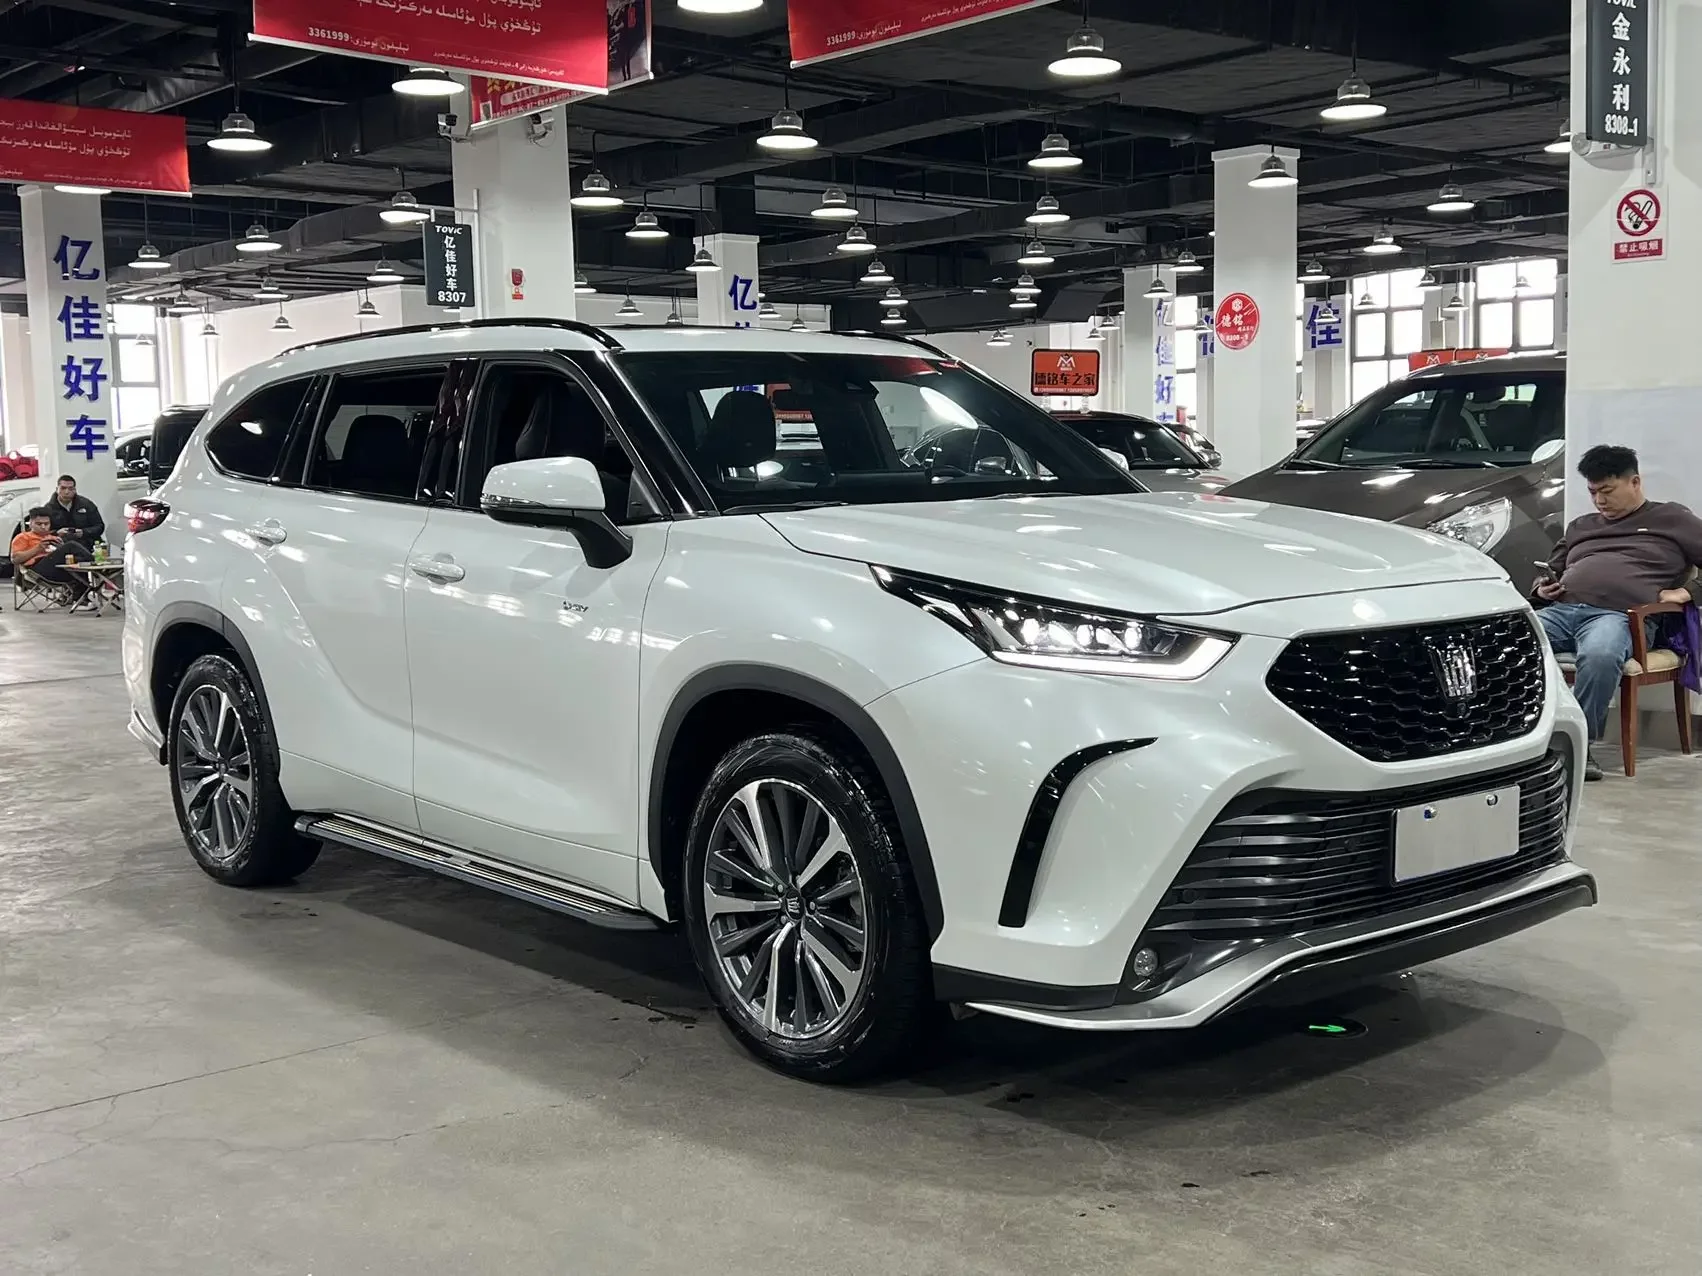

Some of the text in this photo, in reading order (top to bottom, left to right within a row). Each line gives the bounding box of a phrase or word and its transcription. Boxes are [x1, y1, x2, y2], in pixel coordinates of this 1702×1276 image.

[308, 27, 349, 42] 3361999
[1612, 11, 1631, 111] 金永利
[1605, 113, 1638, 136] 8308-1
[1619, 240, 1659, 253] 禁止吸烟
[444, 235, 458, 291] 亿佳好车
[437, 291, 466, 303] 8307
[53, 235, 109, 460] 亿佳好车
